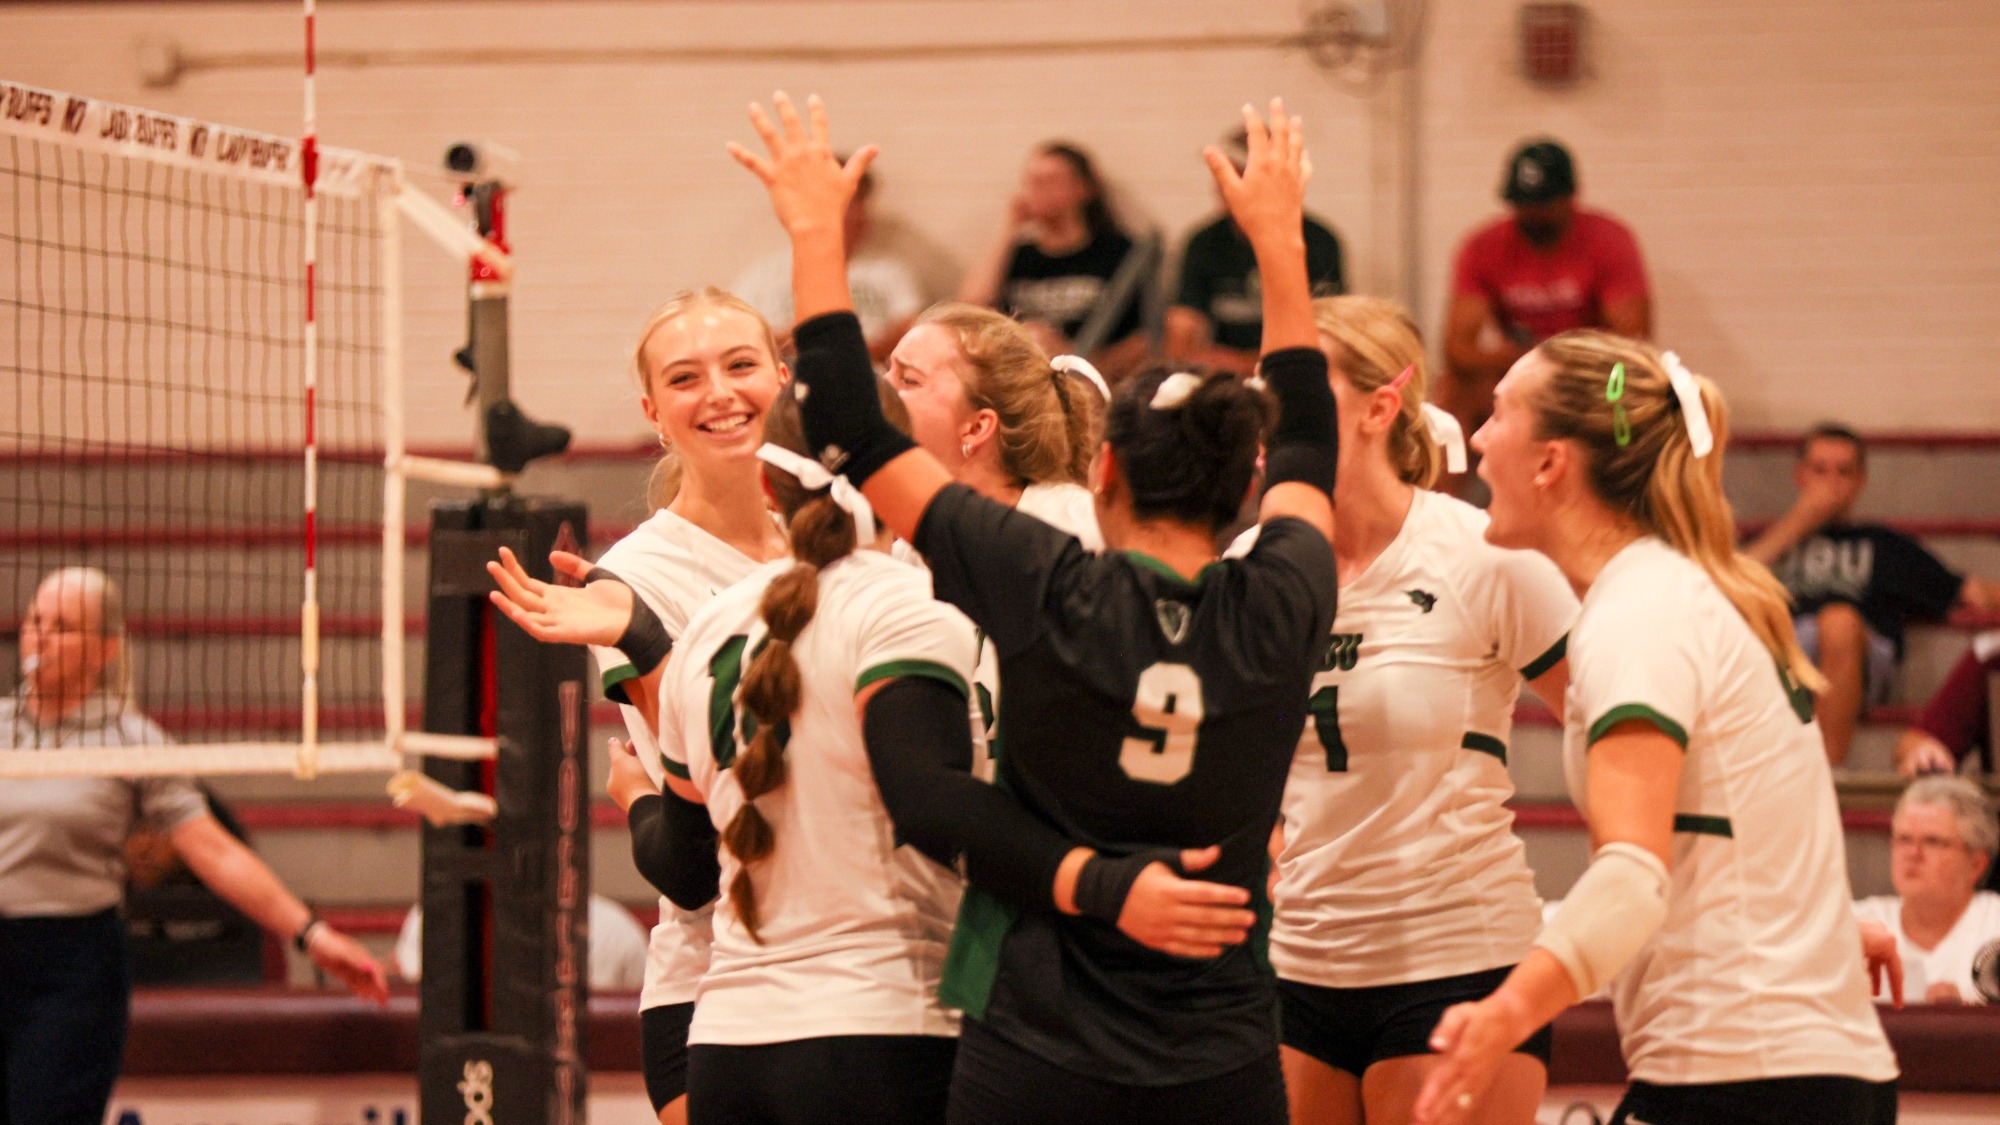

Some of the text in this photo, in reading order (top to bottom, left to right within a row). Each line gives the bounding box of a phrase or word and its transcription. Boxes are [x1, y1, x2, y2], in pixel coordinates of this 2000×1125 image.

[707, 633, 792, 771] 1
[1118, 660, 1205, 785] 9
[1308, 685, 1348, 772] 1
